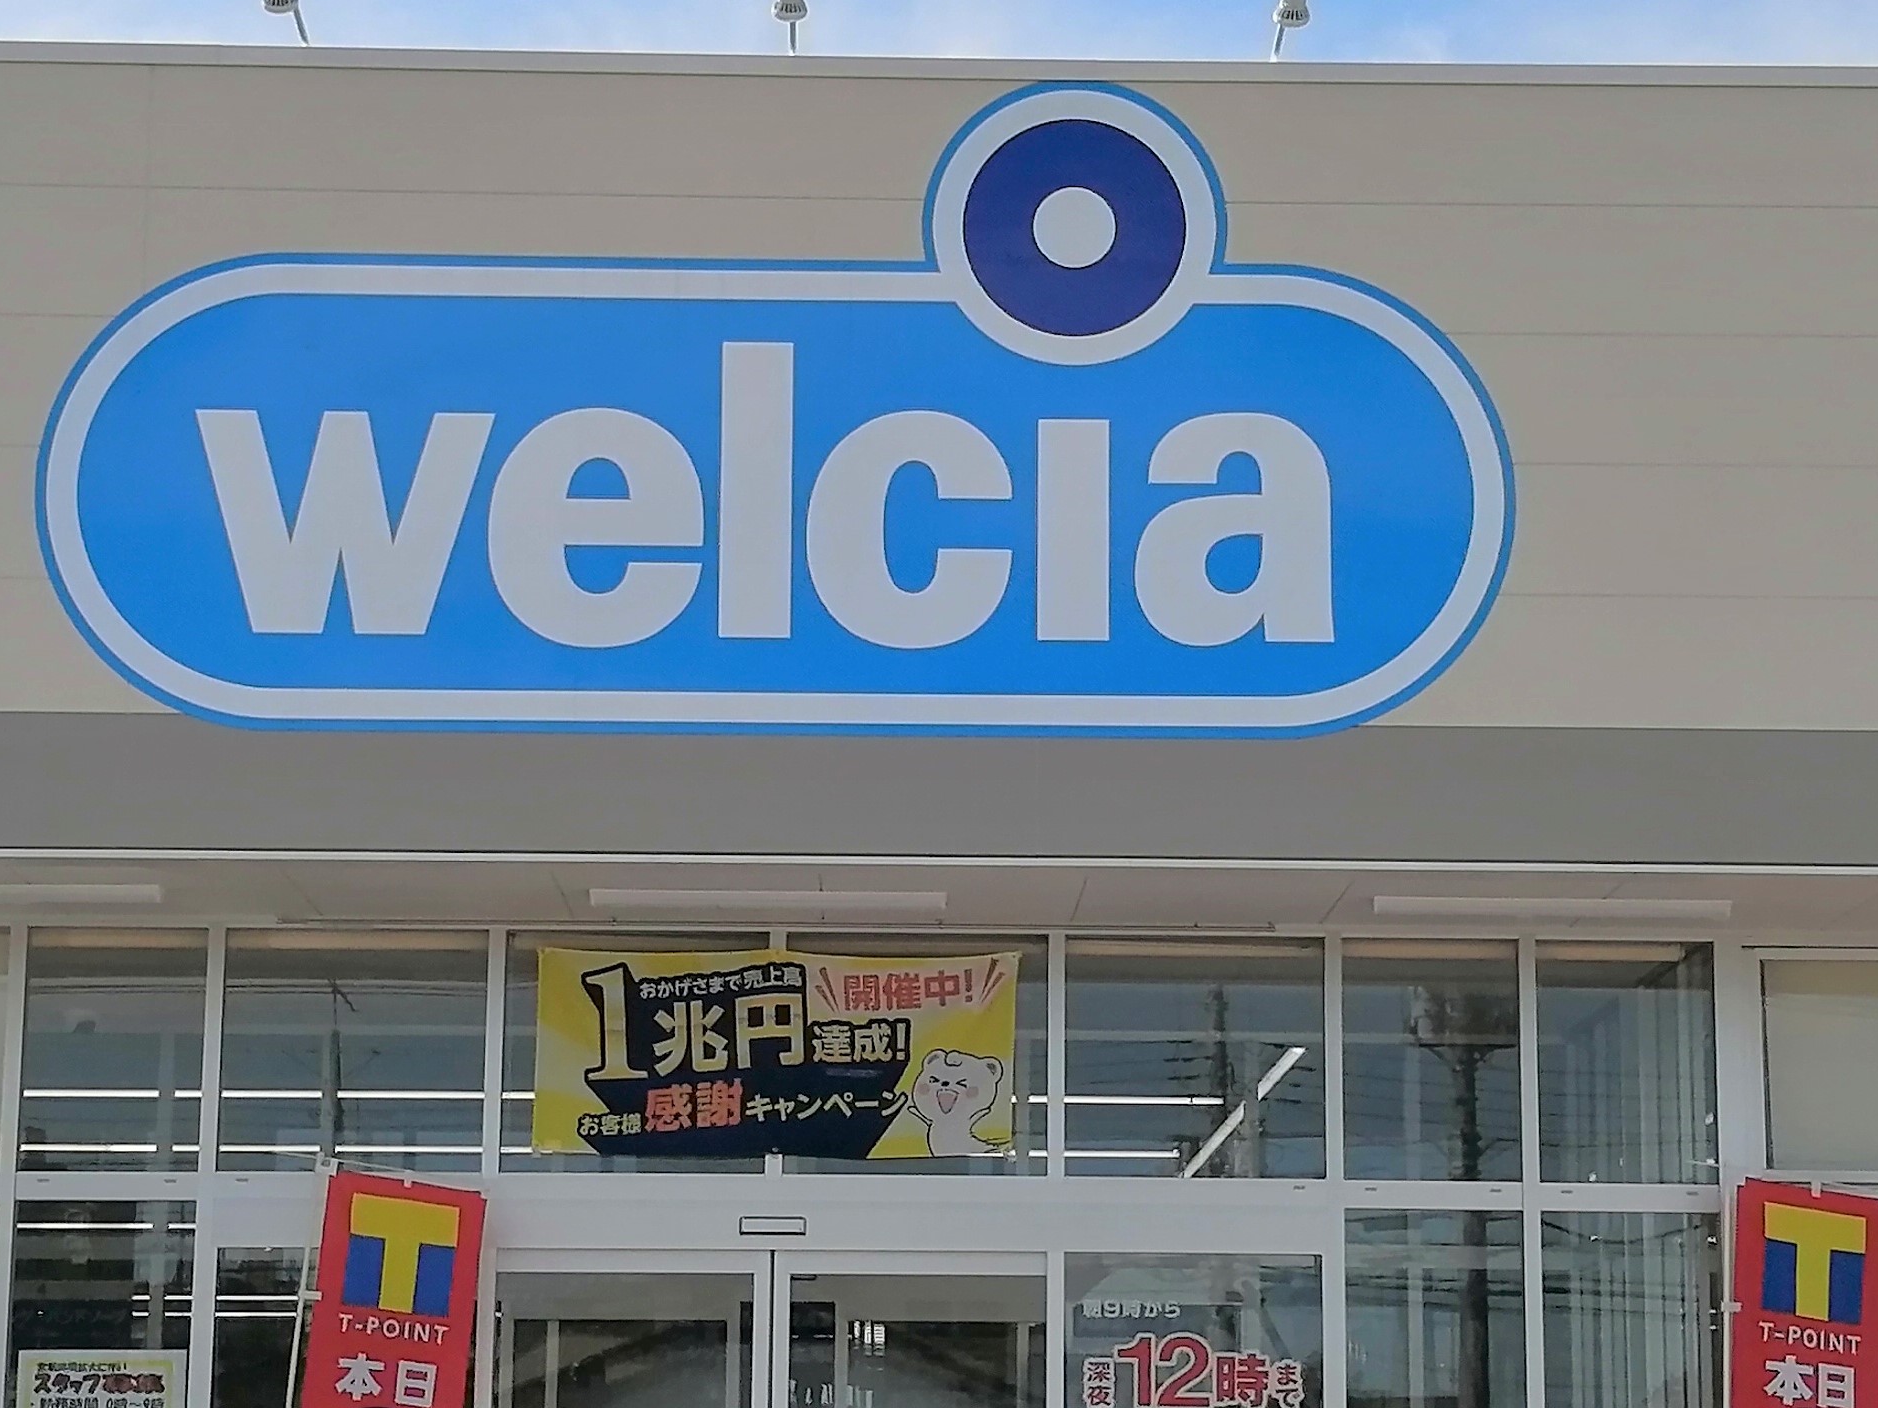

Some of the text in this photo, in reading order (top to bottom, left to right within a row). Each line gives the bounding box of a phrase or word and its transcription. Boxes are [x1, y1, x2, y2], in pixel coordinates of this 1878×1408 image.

[193, 337, 1337, 652] welcia
[638, 965, 802, 1000] おかげさまで売上高
[842, 967, 975, 1011] 開催中!
[338, 1313, 450, 1346] T-POINT
[1759, 1321, 1861, 1356] T-POINT
[333, 1350, 438, 1408] 本日
